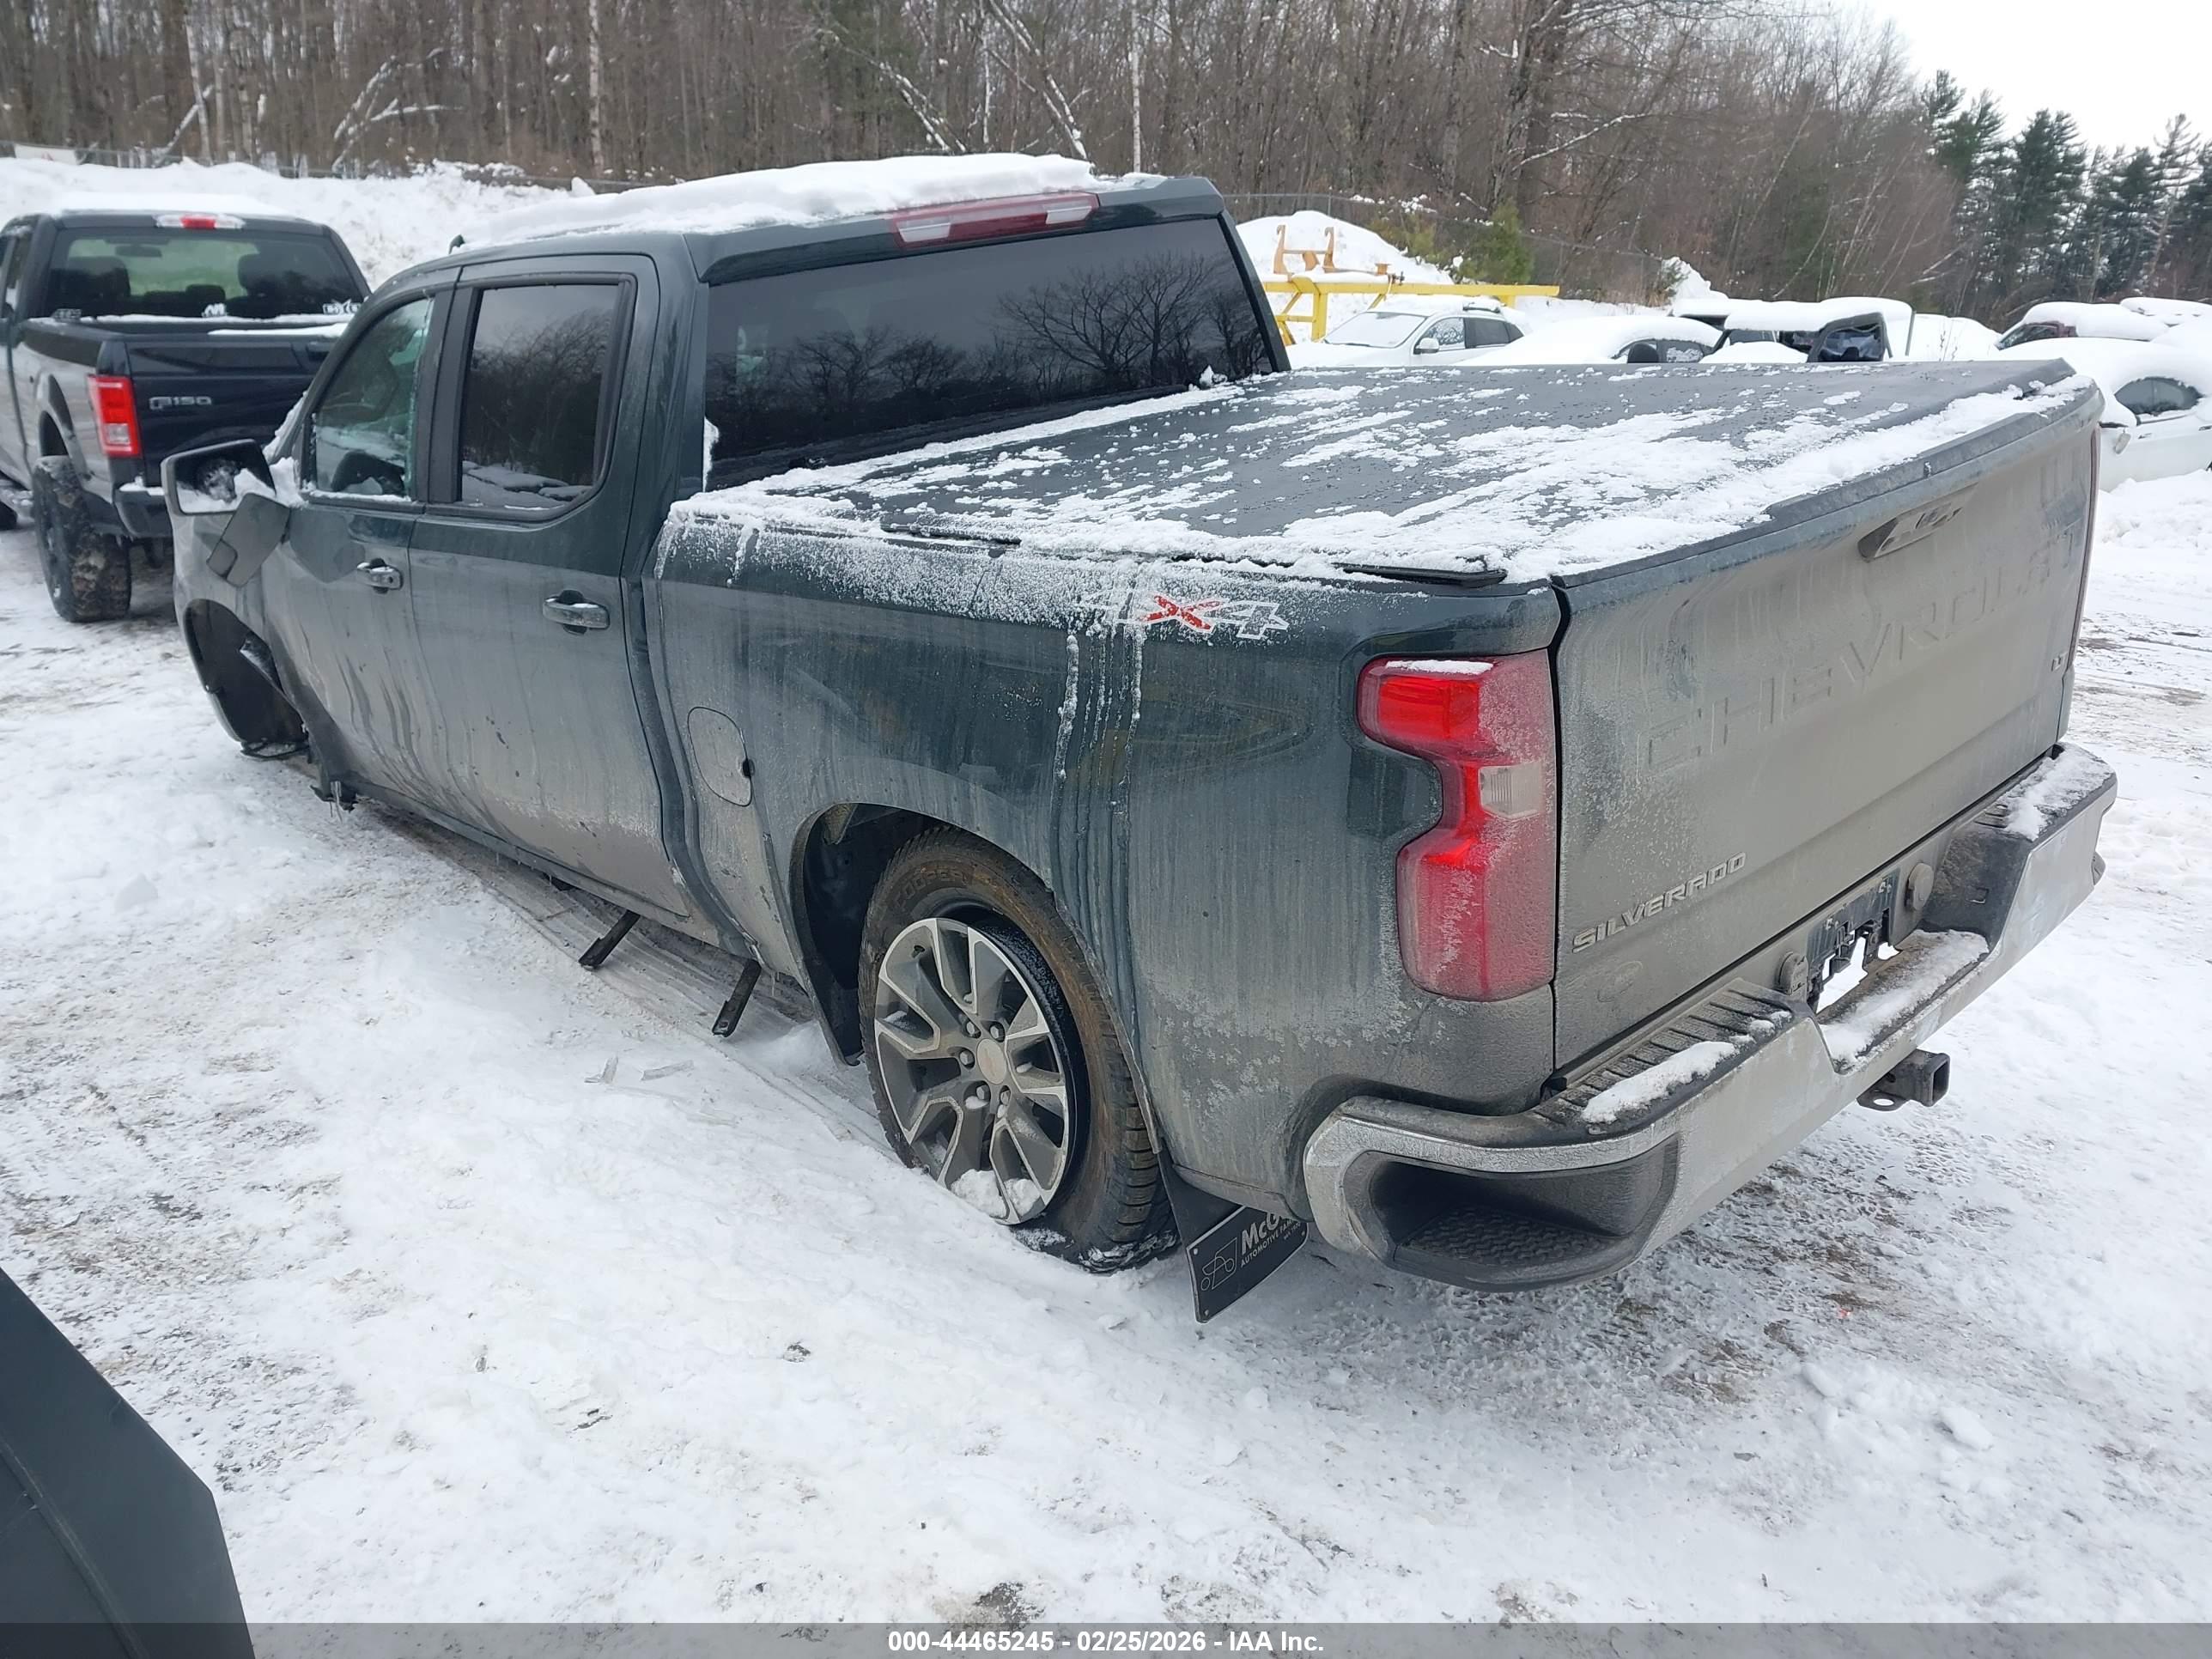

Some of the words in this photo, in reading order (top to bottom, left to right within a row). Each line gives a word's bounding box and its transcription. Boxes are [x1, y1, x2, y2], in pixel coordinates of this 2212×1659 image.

[1572, 851, 1747, 954] SILVERADO
[1241, 1229, 1279, 1267] AUTOMOTIVE
[1242, 1212, 1280, 1255] McG
